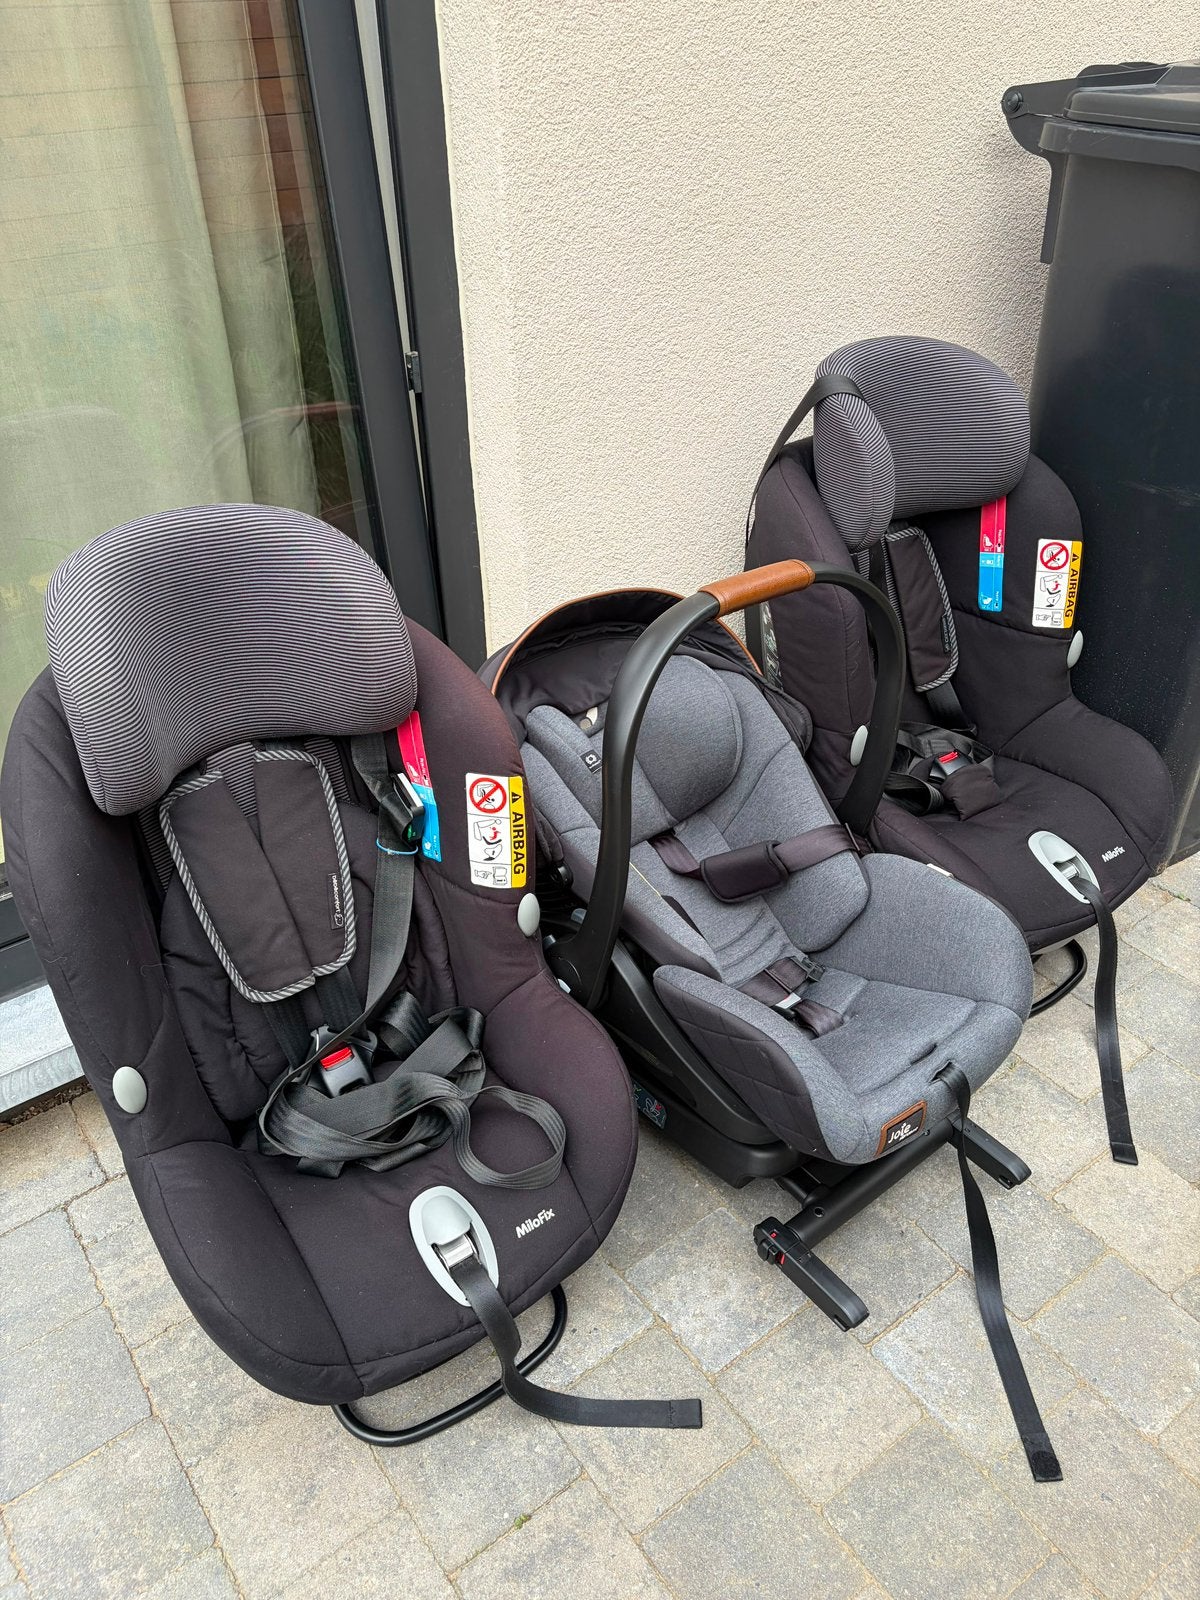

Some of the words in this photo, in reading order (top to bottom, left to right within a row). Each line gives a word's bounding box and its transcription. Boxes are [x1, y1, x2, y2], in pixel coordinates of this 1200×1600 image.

[1065, 568, 1078, 618] AIRBAG
[512, 811, 525, 875] AIRBAG
[1101, 846, 1126, 863] MiloFix
[515, 1208, 556, 1239] MiloFix
